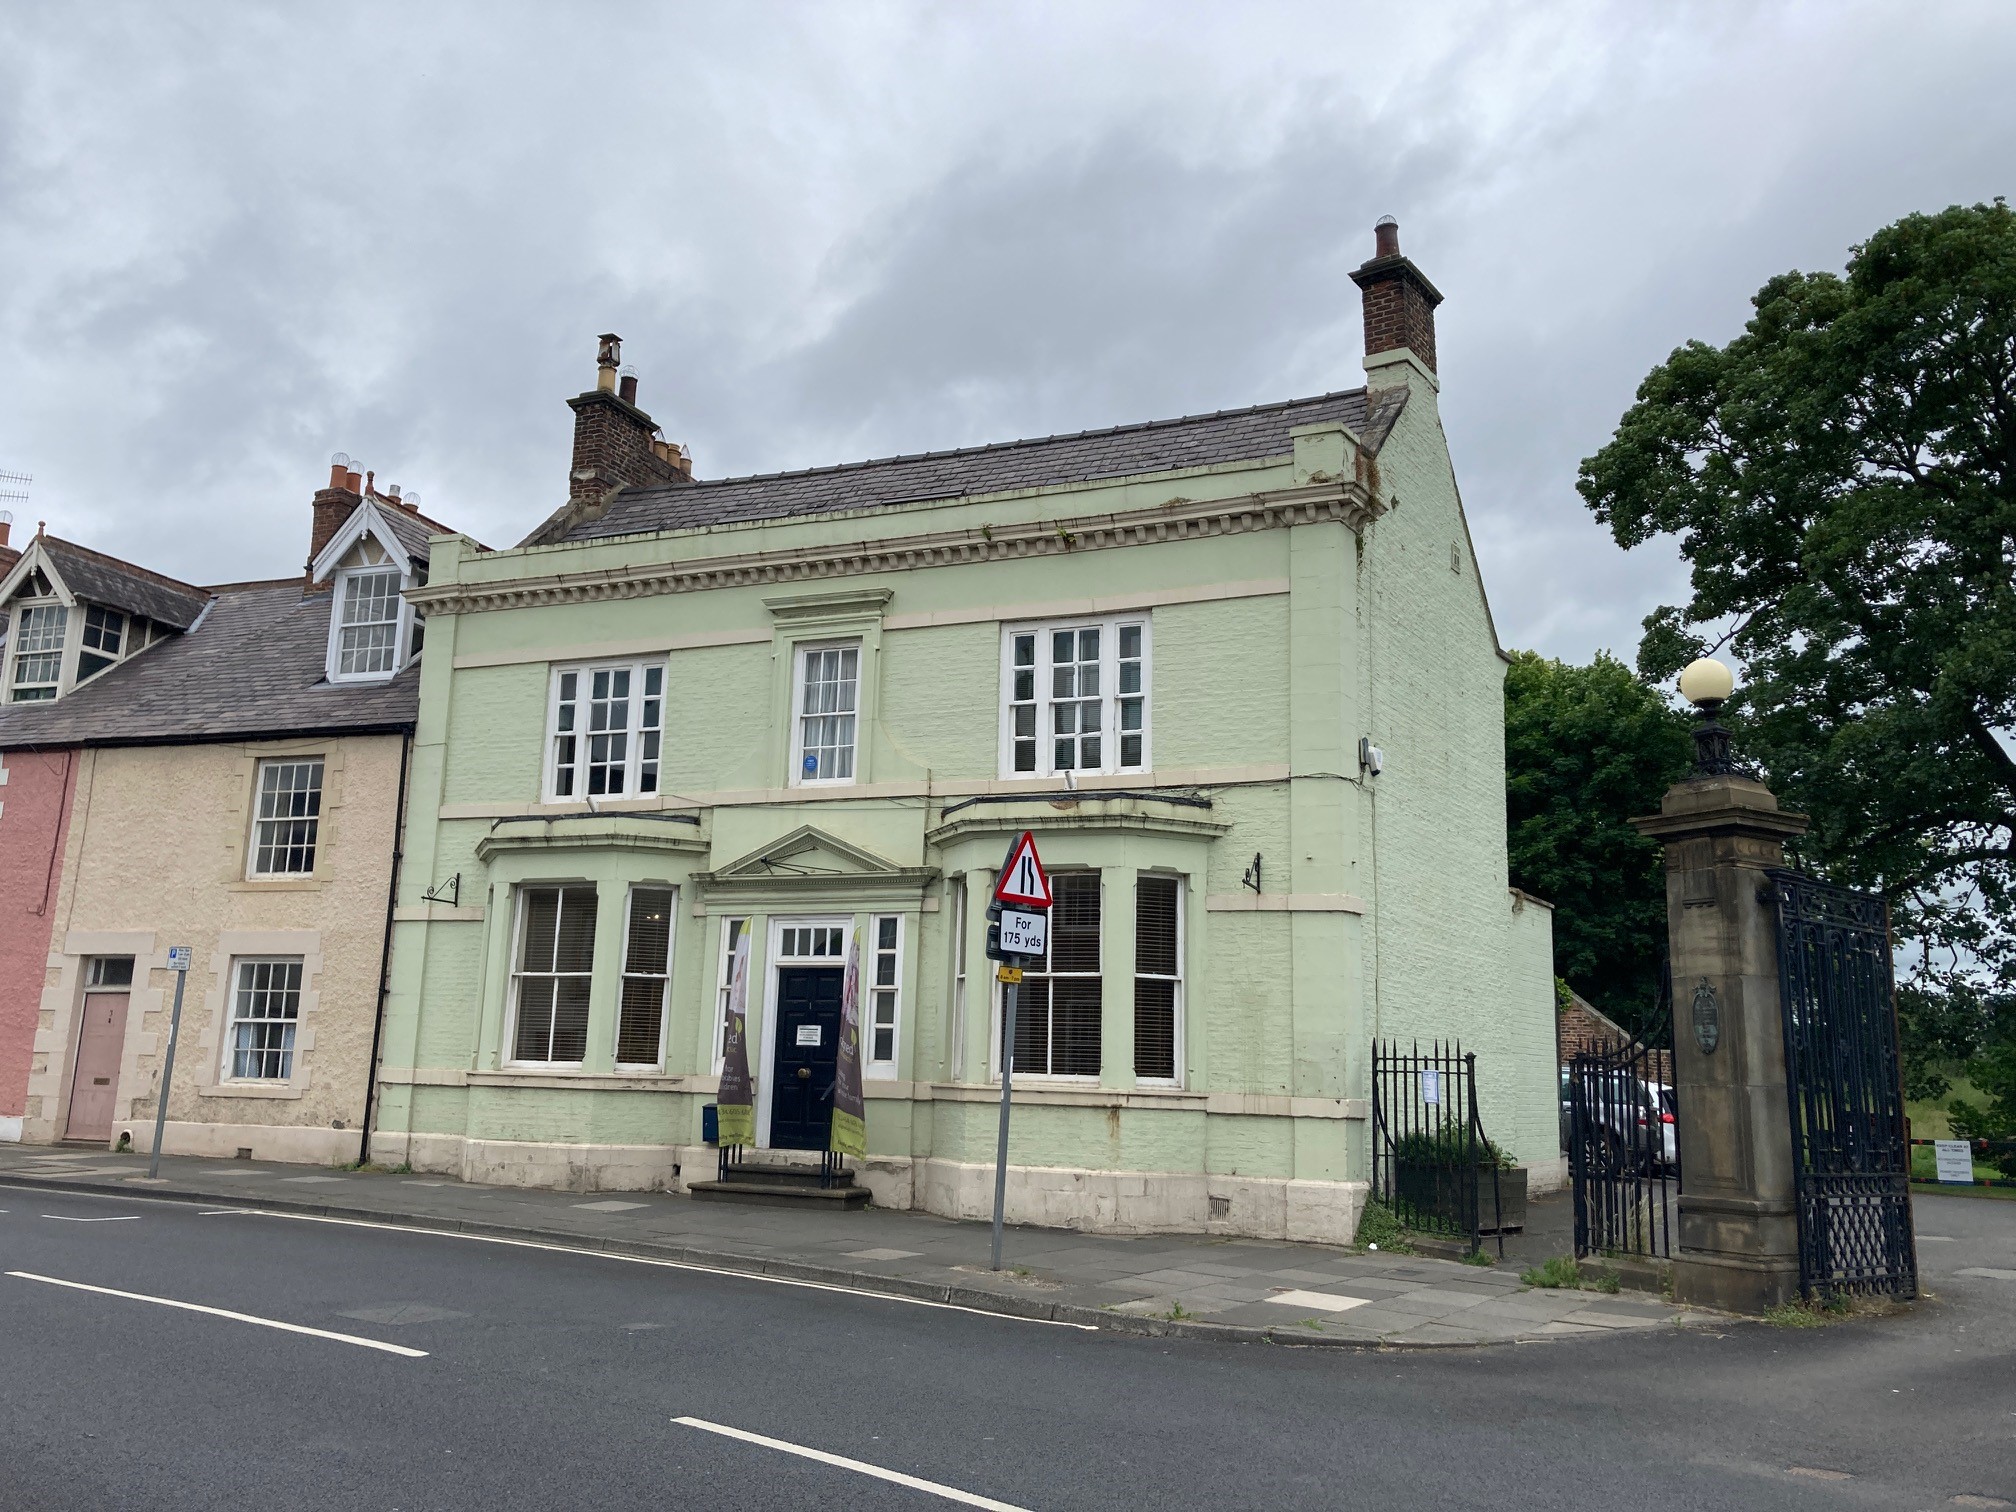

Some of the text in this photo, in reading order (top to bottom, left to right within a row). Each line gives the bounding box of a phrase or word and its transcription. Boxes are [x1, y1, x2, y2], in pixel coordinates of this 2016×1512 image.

[1015, 917, 1031, 930] For
[1004, 931, 1041, 948] 175 yds
